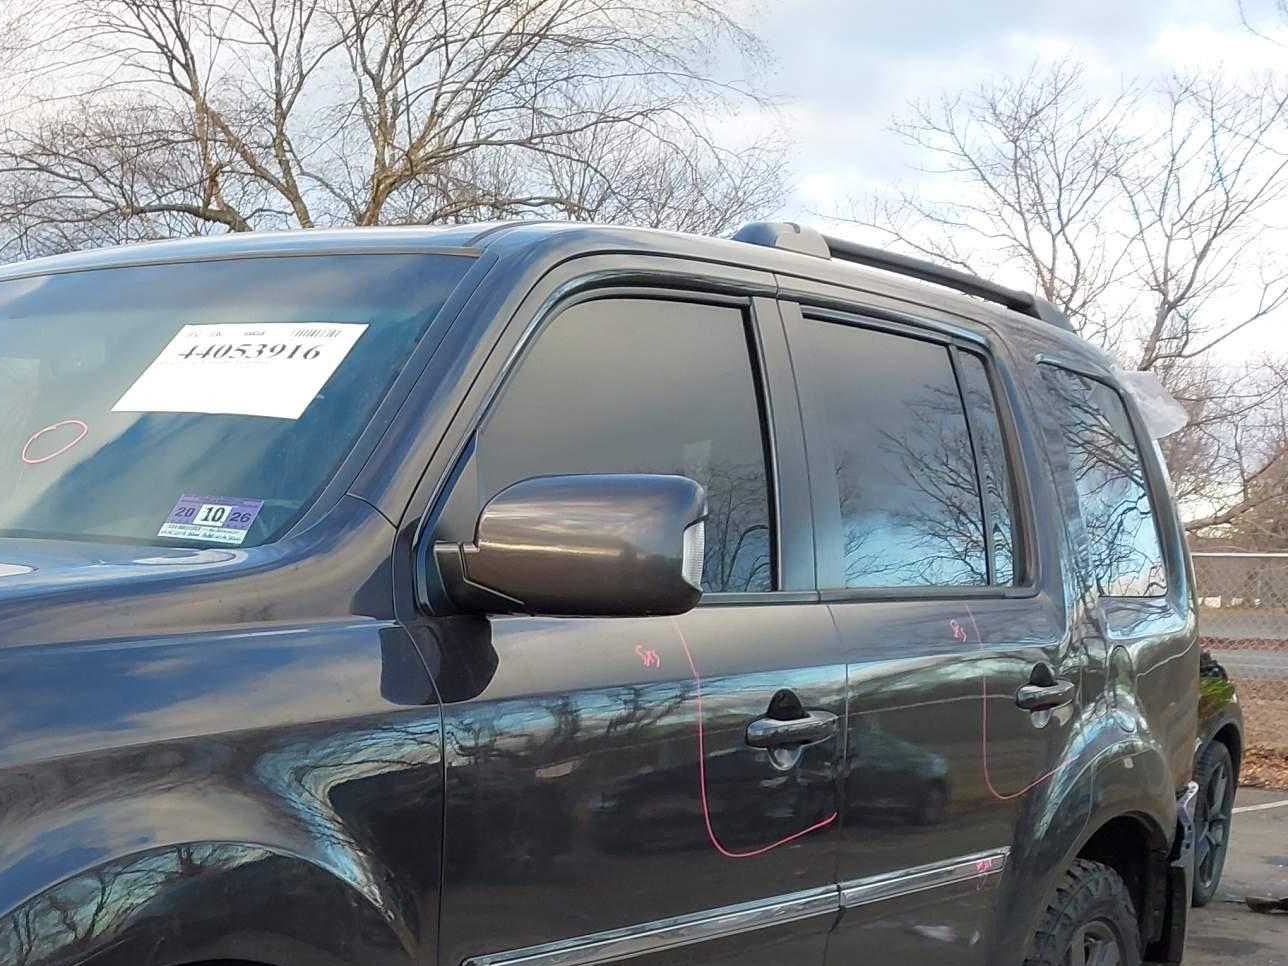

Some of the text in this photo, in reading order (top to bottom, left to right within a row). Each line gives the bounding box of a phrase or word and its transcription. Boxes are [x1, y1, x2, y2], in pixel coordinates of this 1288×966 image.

[177, 343, 324, 360] 44053916
[175, 506, 251, 523] 20 10 26
